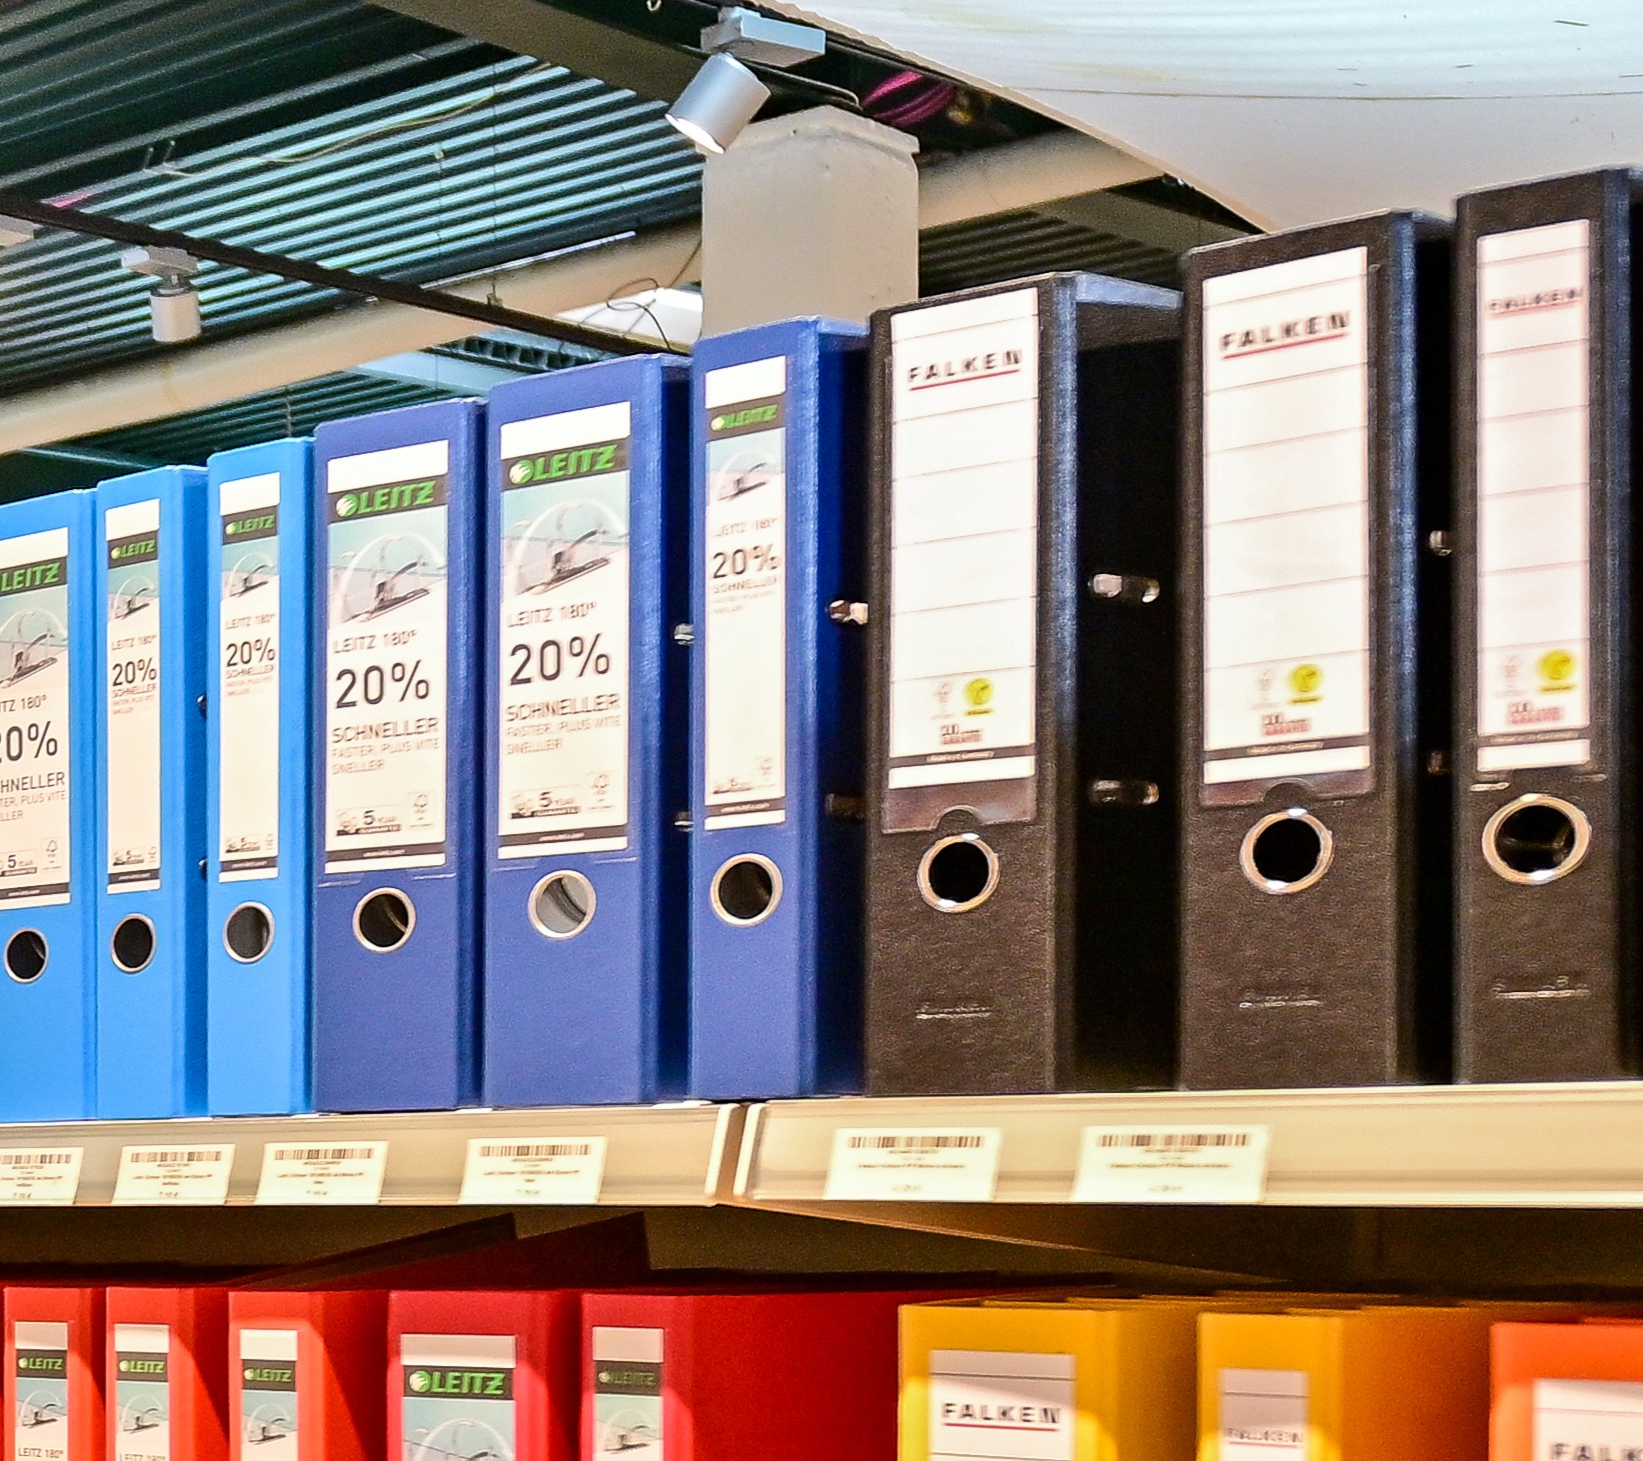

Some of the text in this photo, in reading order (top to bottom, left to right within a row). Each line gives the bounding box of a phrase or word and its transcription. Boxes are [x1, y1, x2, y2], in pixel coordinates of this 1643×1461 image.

[1222, 311, 1350, 350] FALKEN
[910, 350, 1022, 383] FALKEN
[535, 445, 615, 480] LEITZ
[359, 481, 435, 514] LEITZ
[237, 514, 274, 534] LEITZ
[121, 539, 154, 558] LEITZ
[712, 543, 779, 580] 20%
[1, 562, 59, 592] LEITZ
[226, 636, 275, 668] 20%
[510, 631, 610, 689] 20%
[113, 657, 156, 687] 20%
[336, 658, 430, 712] 20%
[507, 690, 619, 722] SCHNELLER
[332, 714, 439, 744] SCHNELLER
[29, 1359, 62, 1370] LEITZ
[130, 1362, 164, 1373] LEITZ
[255, 1370, 291, 1382] LEITZ
[432, 1372, 505, 1394] LEITZ
[942, 1403, 1059, 1424] FALKEN
